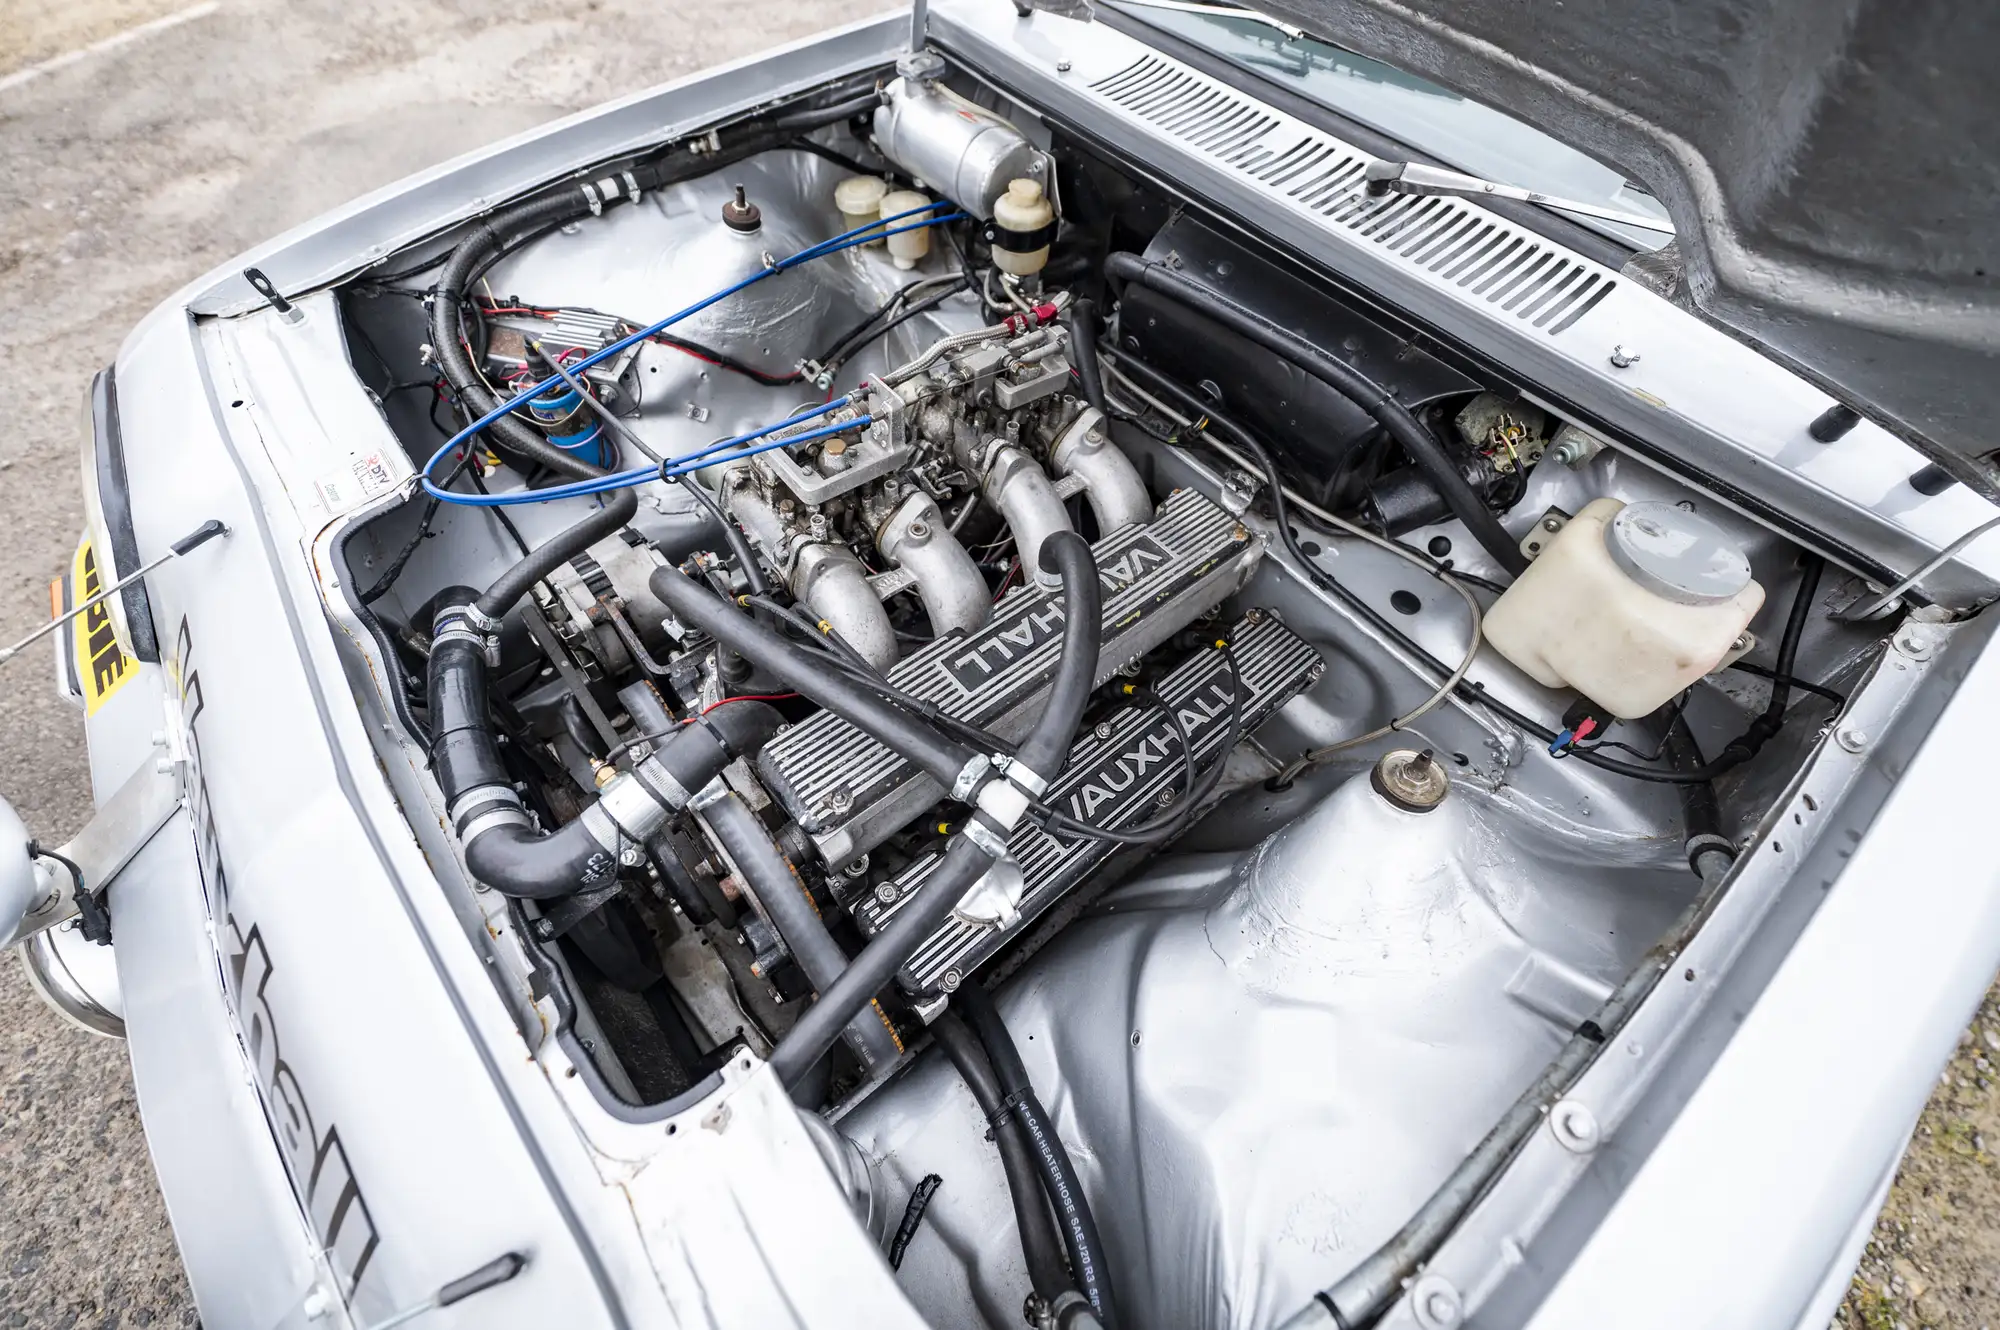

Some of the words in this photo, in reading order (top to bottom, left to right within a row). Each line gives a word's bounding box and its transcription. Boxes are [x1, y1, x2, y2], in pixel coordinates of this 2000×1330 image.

[371, 464, 390, 484] DTV
[954, 548, 1163, 675] VAHALL
[1028, 1118, 1043, 1141] CAR
[1039, 1140, 1062, 1181] HEATER
[1057, 1181, 1076, 1214] HOSE
[1070, 1217, 1085, 1242] SAE
[1078, 1245, 1091, 1264] J20
[1084, 1266, 1095, 1283] R3
